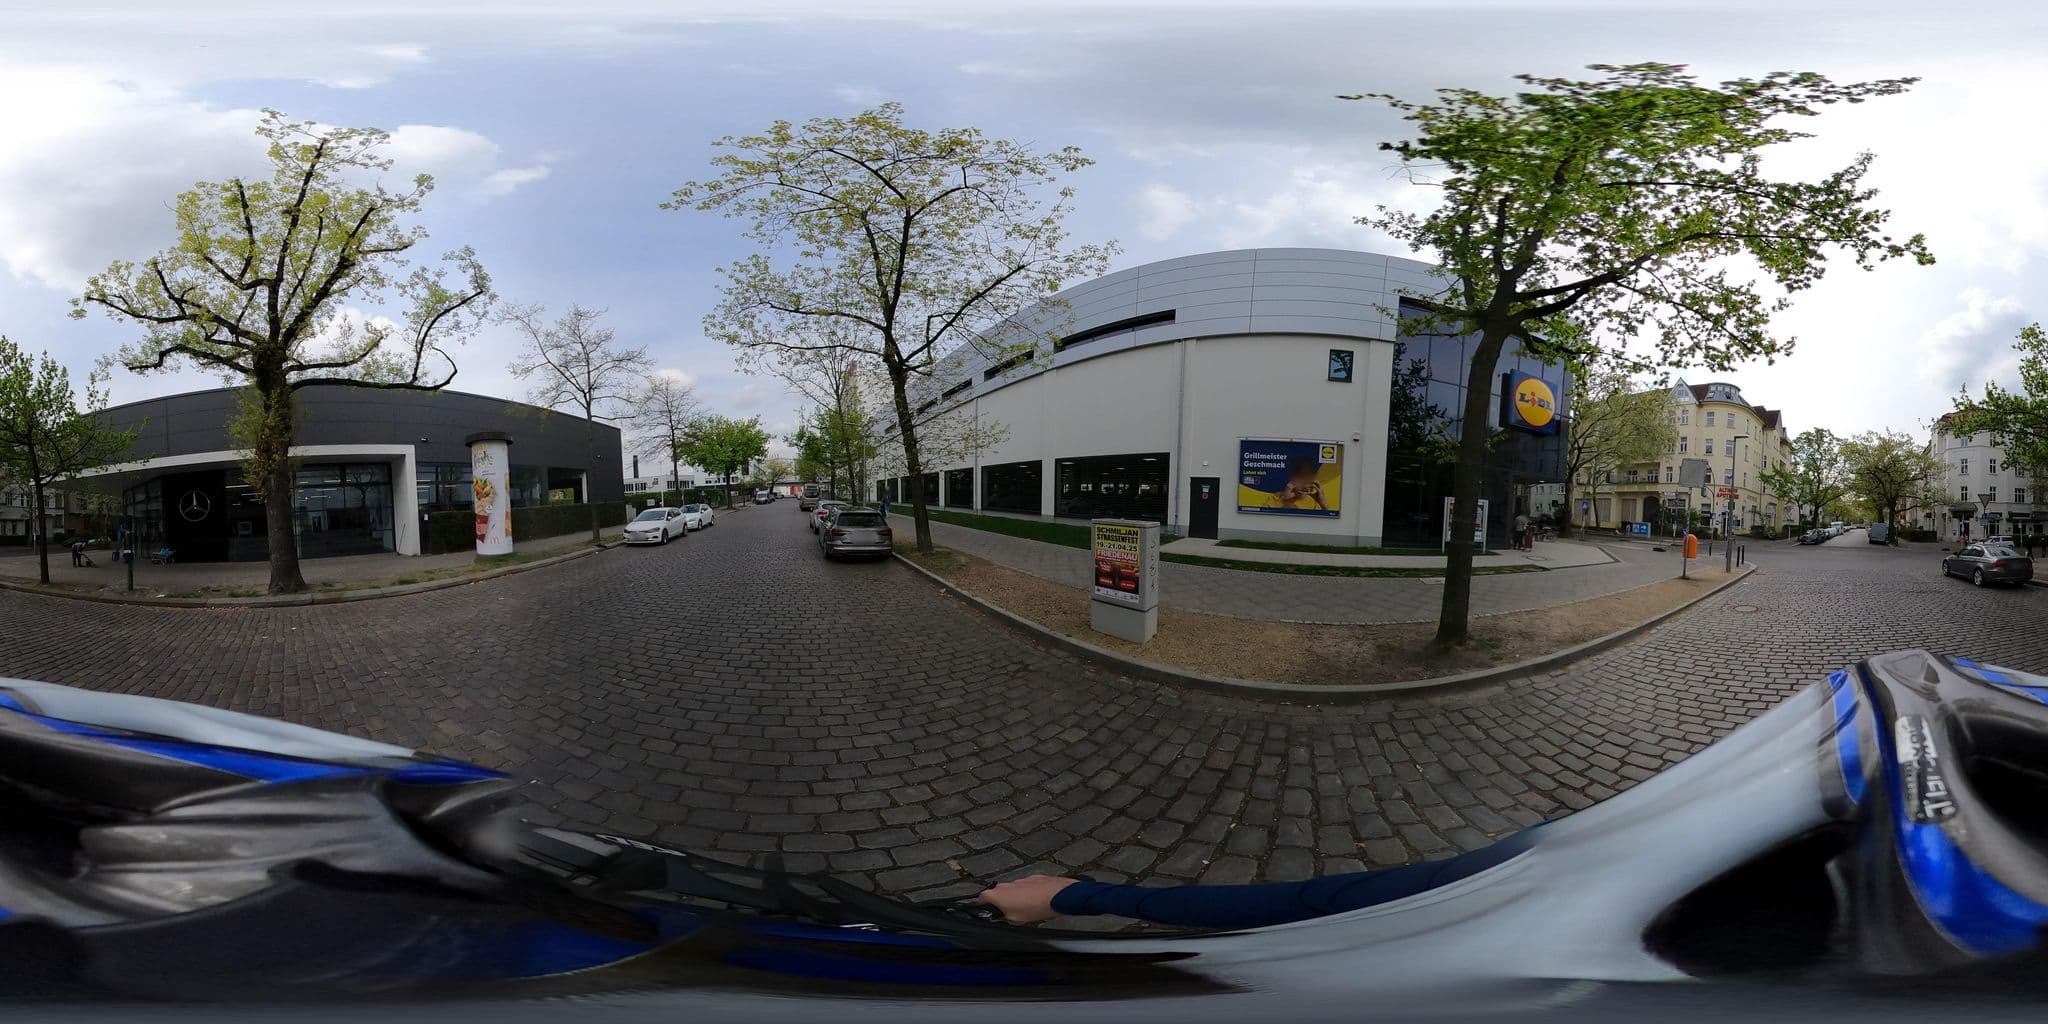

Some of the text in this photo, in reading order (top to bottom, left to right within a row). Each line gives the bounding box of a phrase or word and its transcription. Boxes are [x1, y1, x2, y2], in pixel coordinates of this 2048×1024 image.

[1243, 452, 1288, 461] Grillmeister
[1243, 460, 1286, 469] Geschmack
[1097, 527, 1139, 536] SCHMILJAN
[1097, 534, 1138, 544] STRASSENFEST
[1097, 541, 1138, 551] 19.-21.04.25
[1097, 550, 1138, 560] FRIEDENAU
